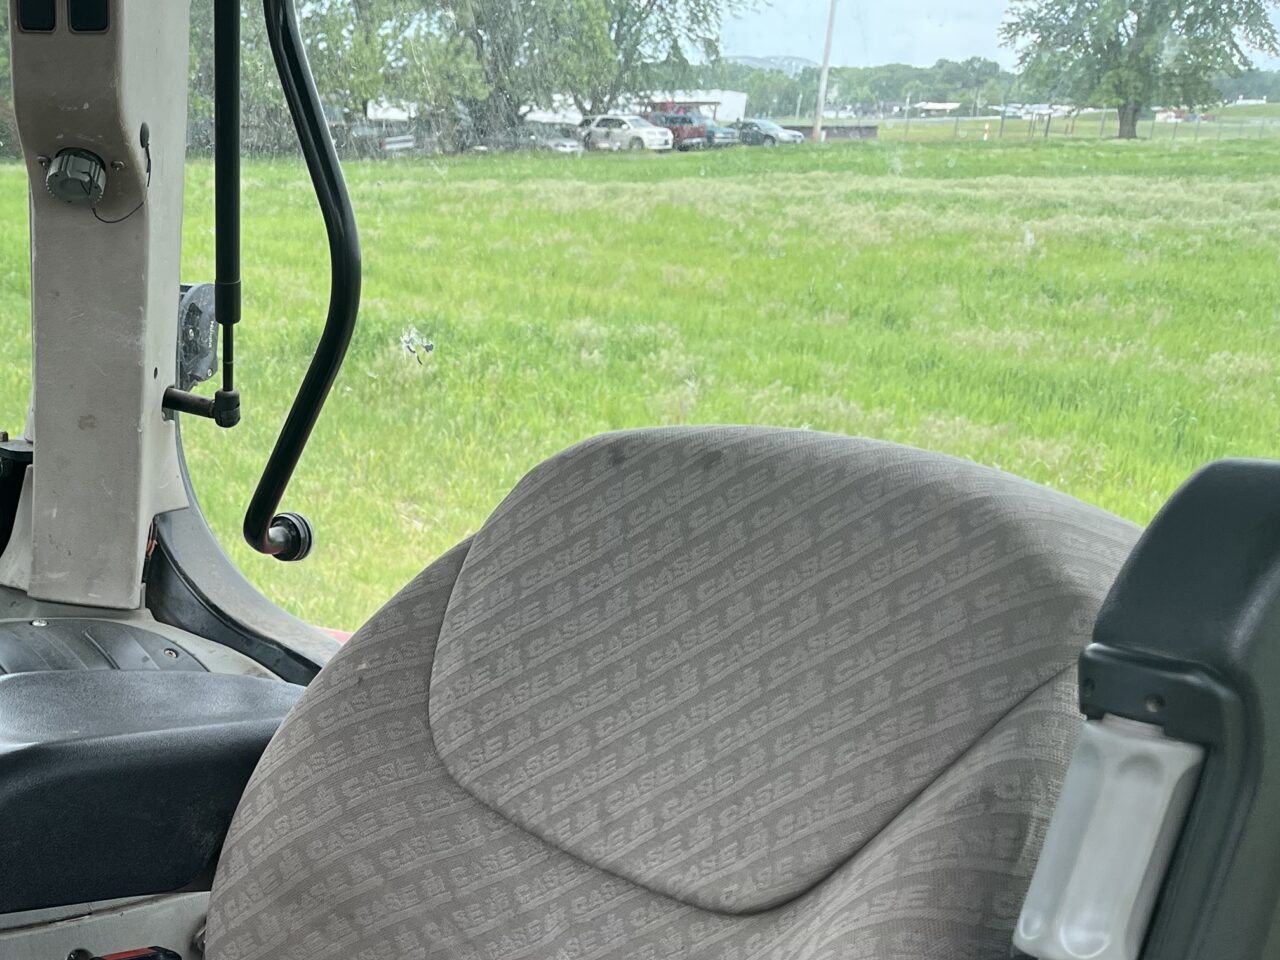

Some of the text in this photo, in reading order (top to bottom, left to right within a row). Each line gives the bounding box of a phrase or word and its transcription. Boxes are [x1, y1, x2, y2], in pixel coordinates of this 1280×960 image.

[572, 470, 644, 525] CASE
[628, 469, 703, 525] CASE
[689, 469, 768, 528] CASE
[753, 469, 837, 527] CASE
[820, 469, 912, 527] CASE
[522, 537, 592, 587] CASE
[579, 539, 650, 595] CASE
[636, 542, 710, 598] CASE
[698, 541, 774, 601] CASE
[762, 540, 843, 598] CASE
[827, 540, 919, 604] CASE
[900, 540, 996, 603] CASE
[471, 602, 541, 646] CASE
[527, 607, 600, 657] CASE
[587, 612, 659, 663] CASE
[646, 615, 719, 669] CASE
[706, 617, 783, 677] CASE
[768, 618, 852, 677] CASE
[833, 622, 922, 682] CASE
[900, 626, 1003, 687] CASE
[481, 673, 549, 721] CASE
[539, 679, 608, 729] CASE
[596, 686, 668, 737] CASE
[655, 690, 728, 744] CASE
[715, 693, 790, 749] CASE
[774, 698, 854, 754] CASE
[835, 705, 925, 764] CASE
[281, 740, 345, 789] CASE
[342, 757, 418, 799] CASE
[496, 744, 561, 793] CASE
[552, 753, 617, 804] CASE
[605, 759, 675, 813] CASE
[662, 766, 735, 818] CASE
[720, 773, 793, 825] CASE
[248, 805, 309, 853] CASE
[306, 812, 378, 859] CASE
[380, 829, 451, 868] CASE
[450, 846, 517, 886] CASE
[225, 872, 278, 918] CASE
[355, 884, 418, 926] CASE
[423, 902, 486, 942] CASE
[488, 920, 541, 958] CASE
